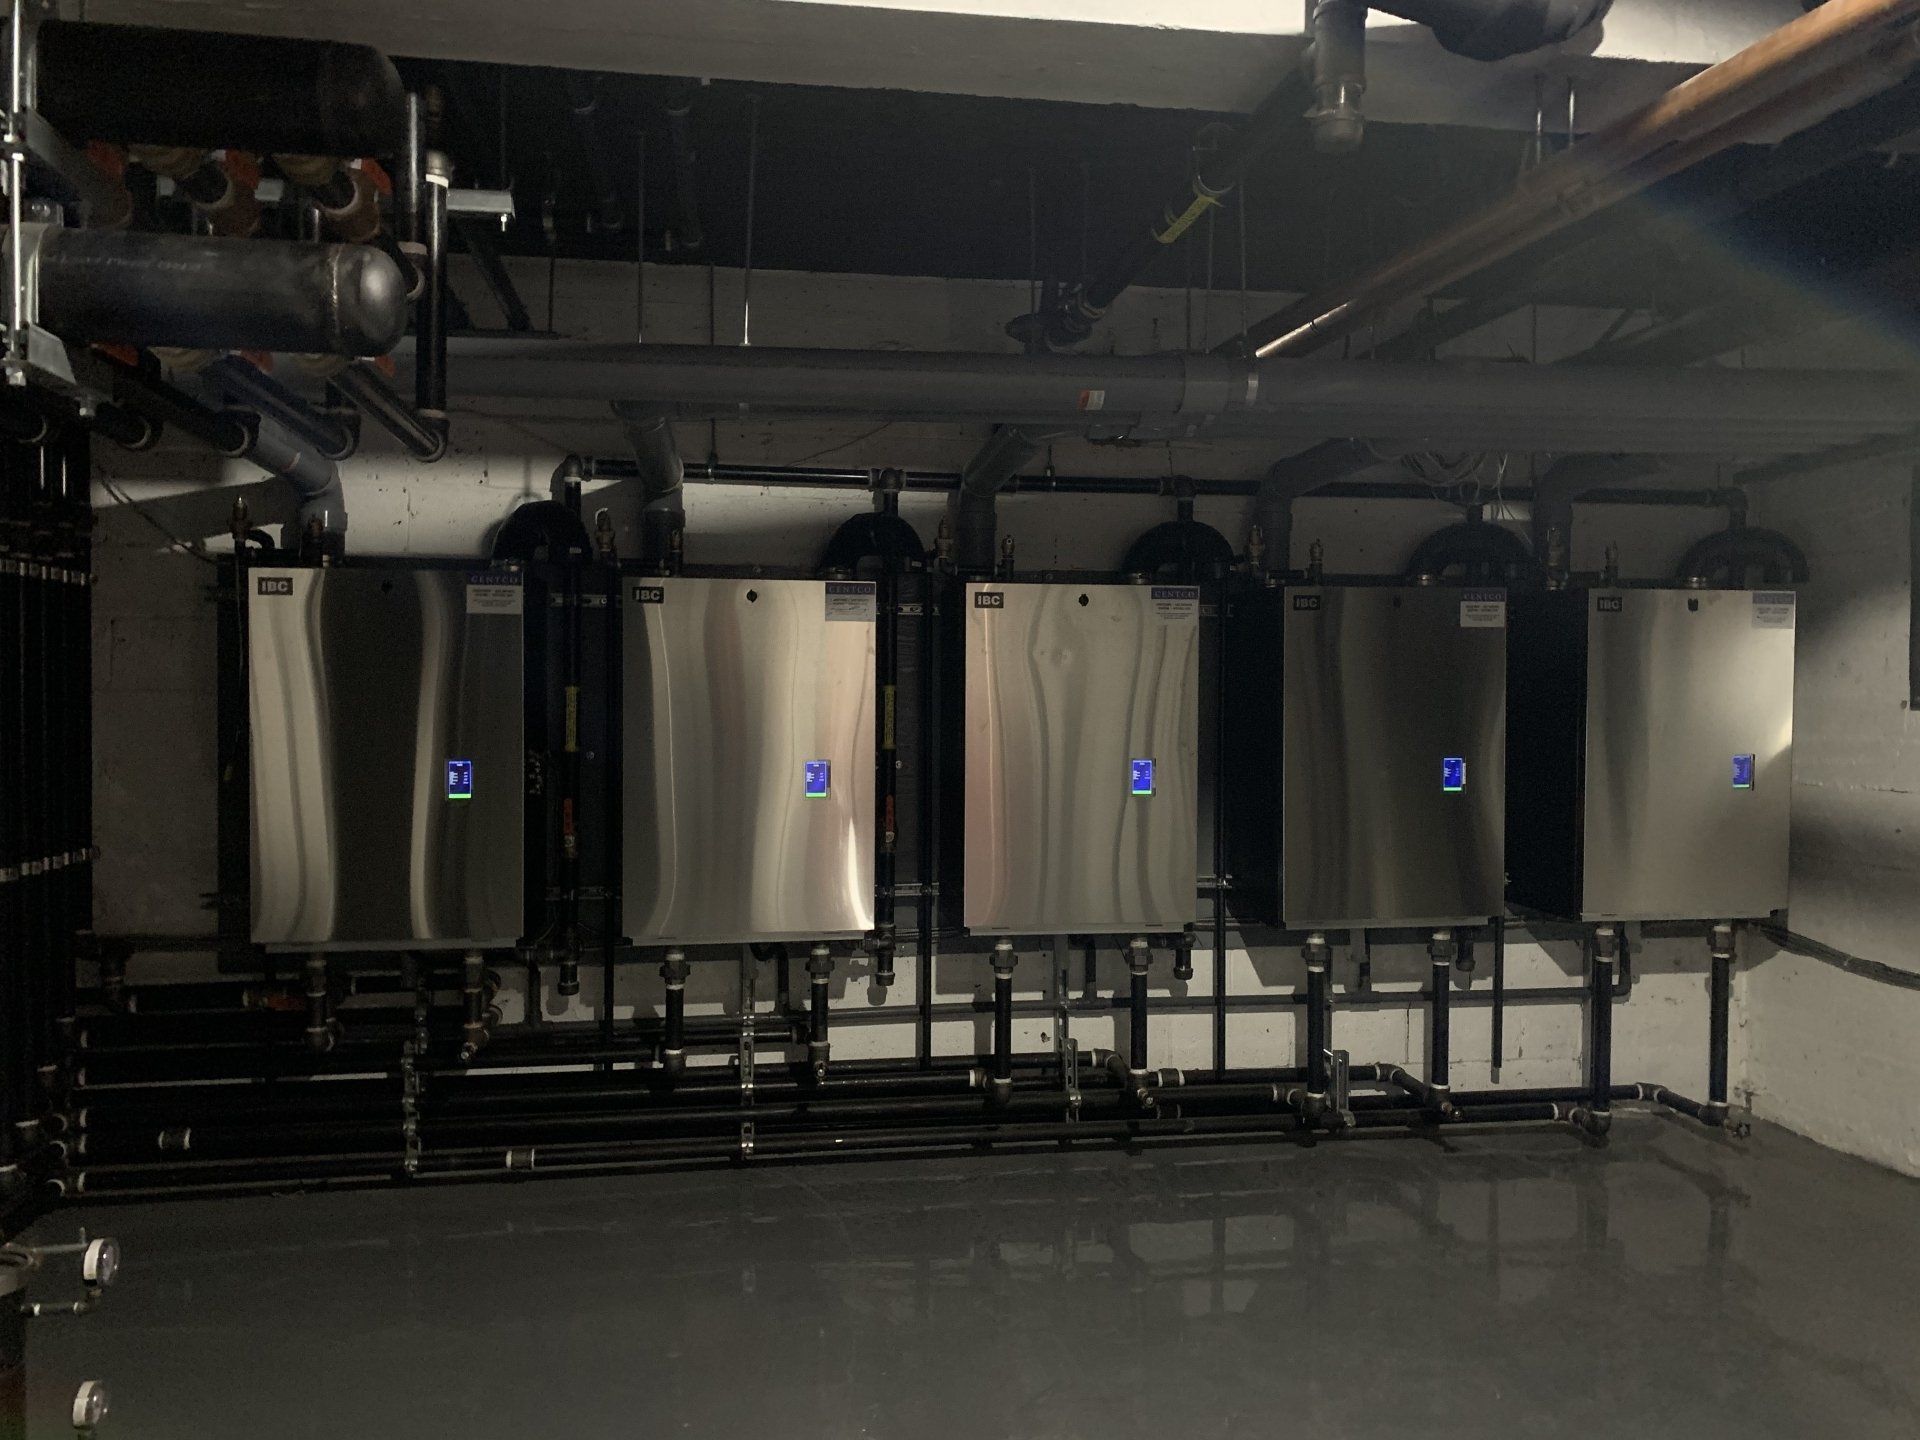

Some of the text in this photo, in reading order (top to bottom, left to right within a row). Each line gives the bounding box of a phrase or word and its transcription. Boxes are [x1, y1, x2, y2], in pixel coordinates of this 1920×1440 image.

[261, 581, 288, 591] IBC
[635, 589, 660, 600] IBC
[1153, 590, 1195, 598] CENTCO
[977, 595, 1001, 605] IBC
[1296, 598, 1318, 607] IBC
[1599, 599, 1619, 609] IBC
